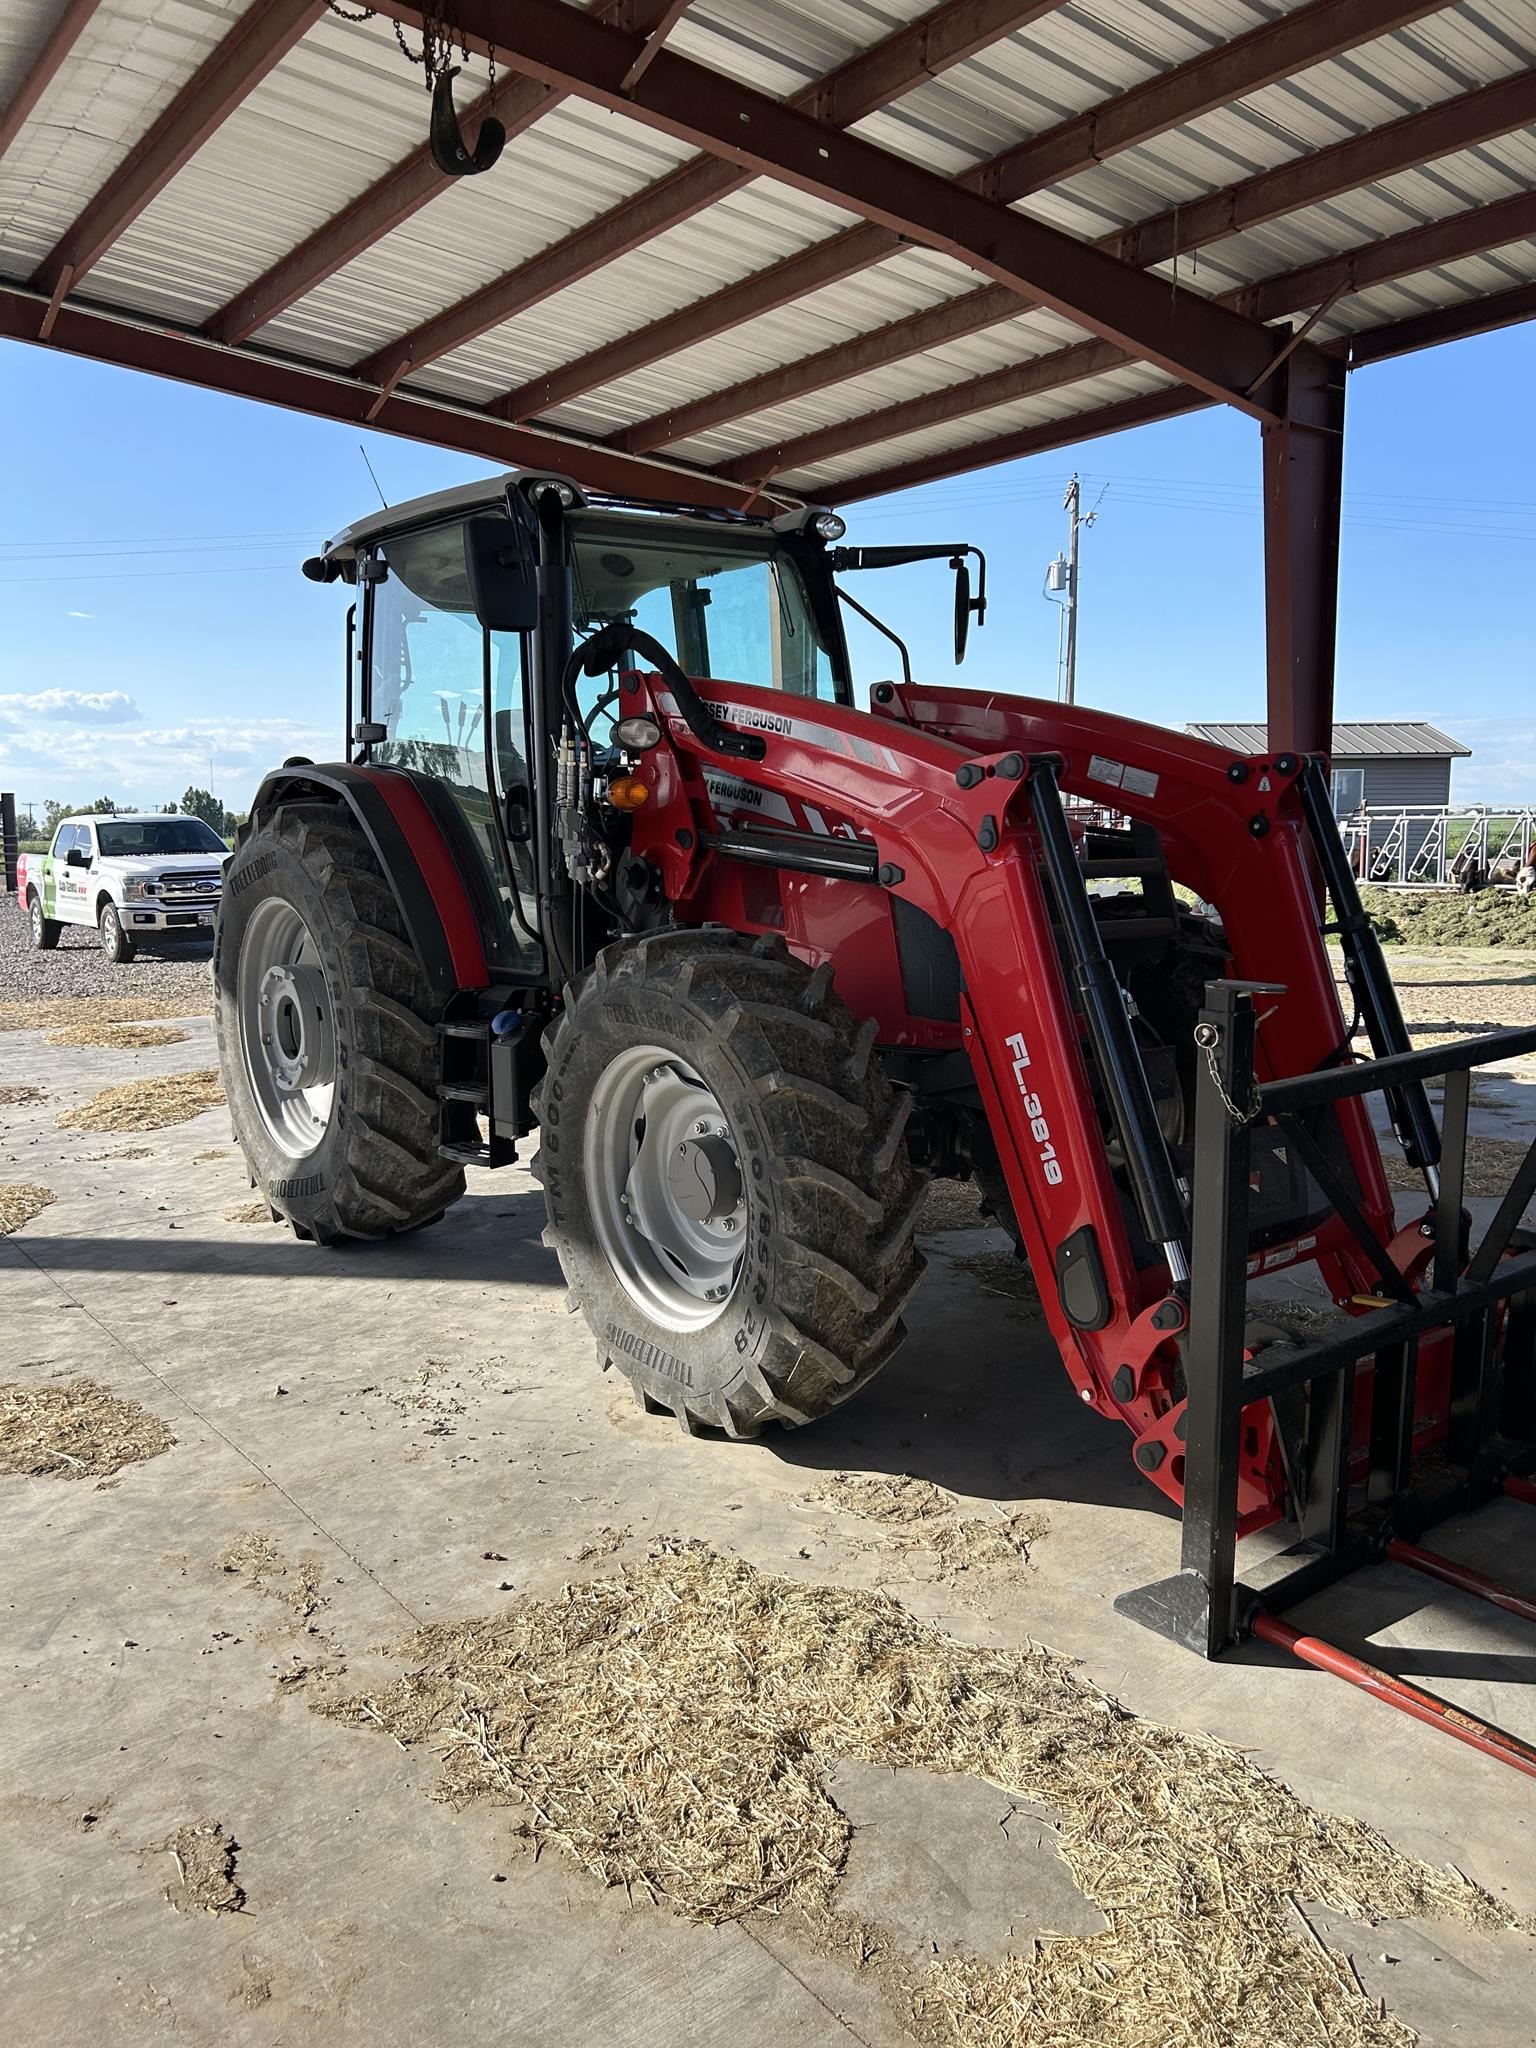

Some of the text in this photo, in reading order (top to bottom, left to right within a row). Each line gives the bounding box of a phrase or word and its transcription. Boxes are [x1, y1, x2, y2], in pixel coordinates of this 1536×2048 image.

[731, 707, 793, 735] FERGUSON
[709, 779, 763, 807] FERGUSON
[229, 851, 278, 897] TRELLEBORG
[606, 1322, 695, 1389] TRELLEBORG
